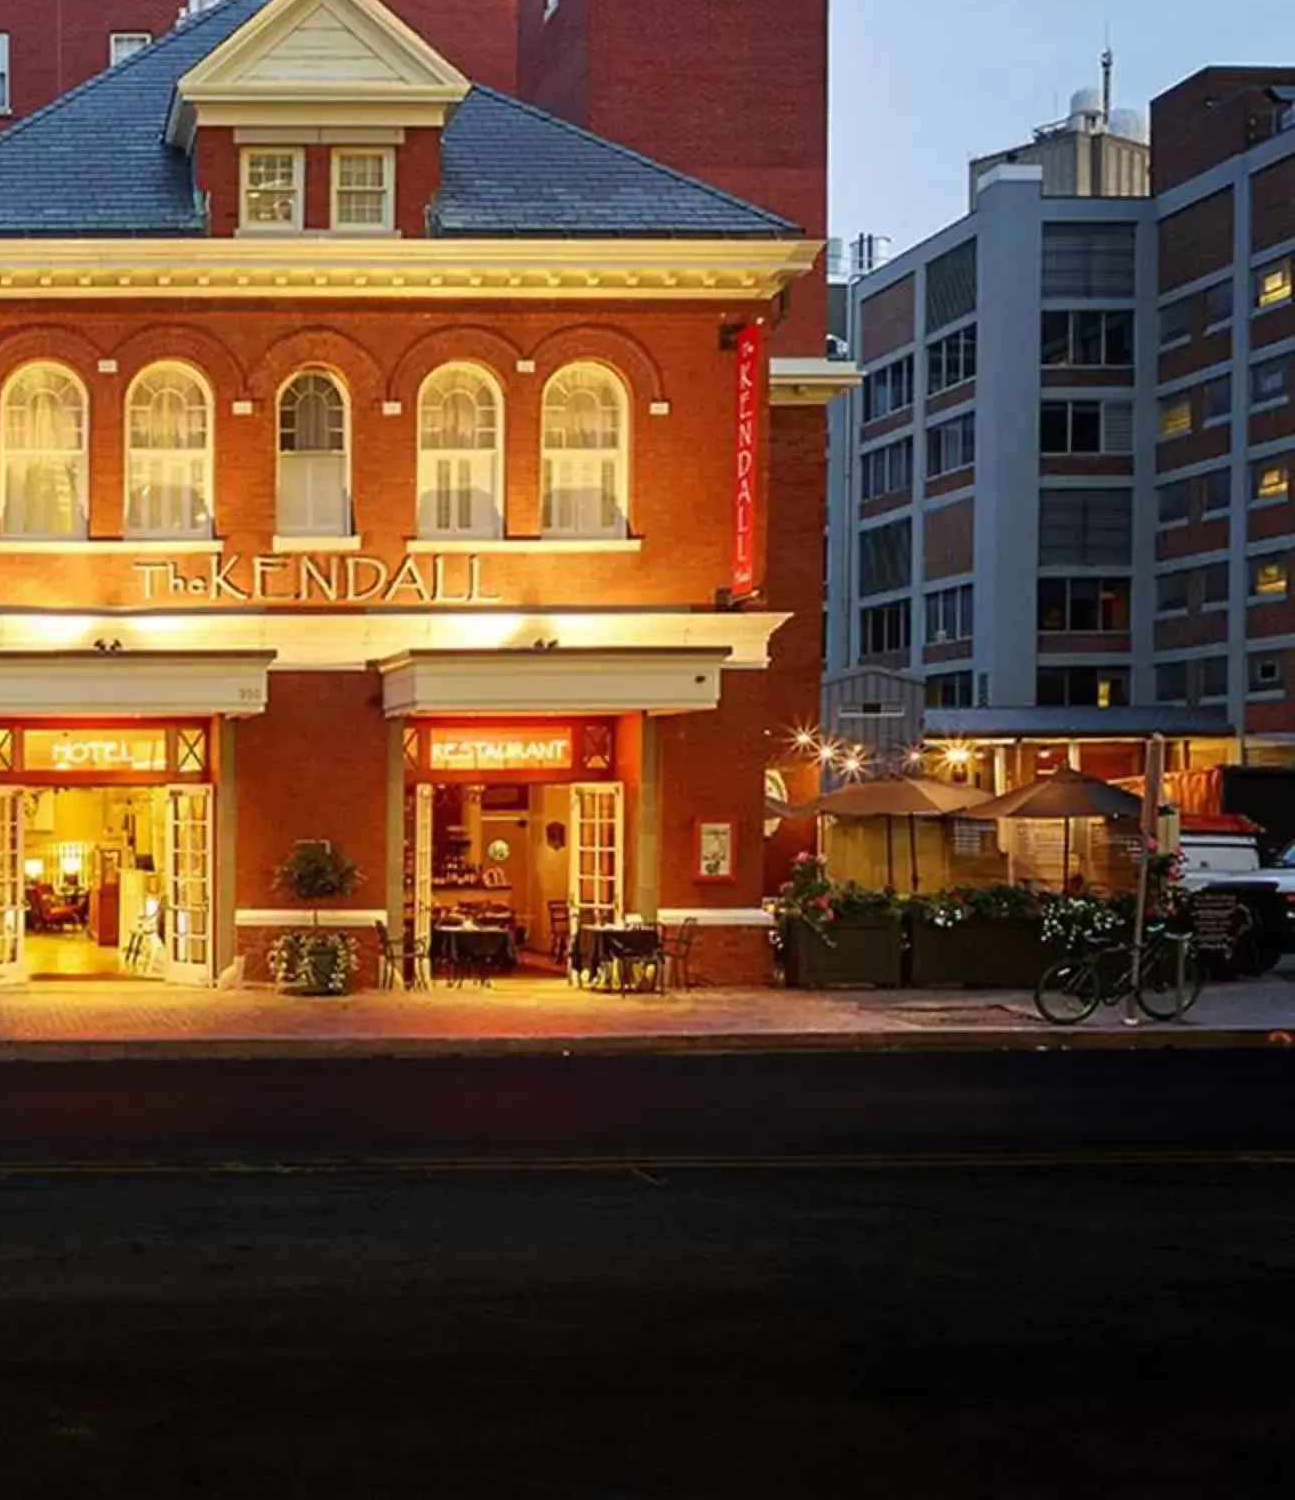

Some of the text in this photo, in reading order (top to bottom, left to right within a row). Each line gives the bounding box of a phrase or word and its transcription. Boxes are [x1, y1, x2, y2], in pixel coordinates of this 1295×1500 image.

[736, 363, 753, 562] KENDALL
[132, 553, 502, 601] The KENDALL
[431, 739, 568, 762] RESTAURANT
